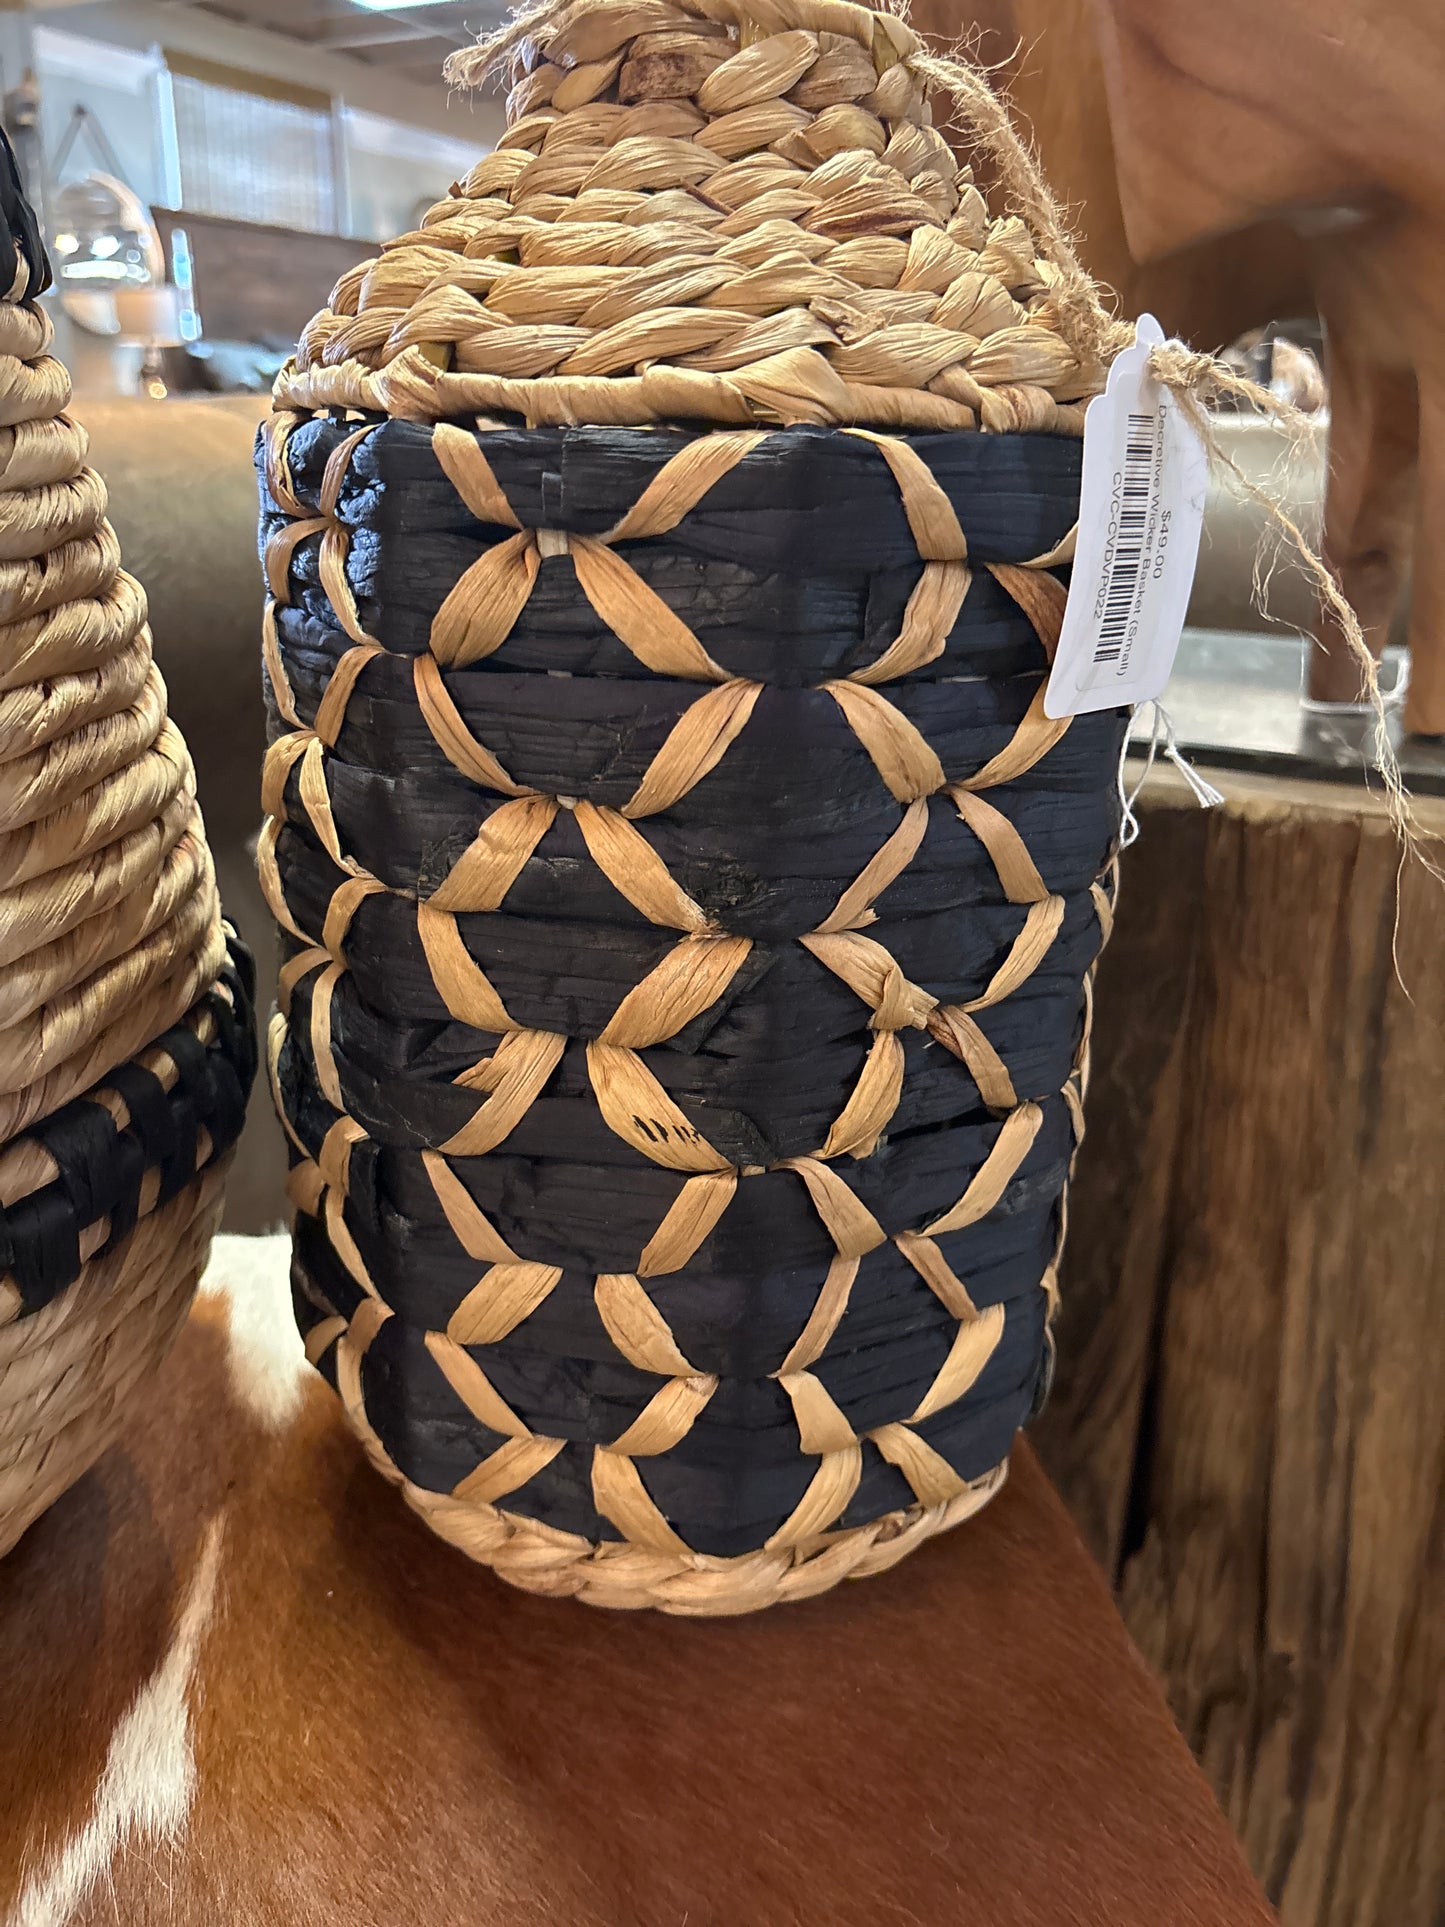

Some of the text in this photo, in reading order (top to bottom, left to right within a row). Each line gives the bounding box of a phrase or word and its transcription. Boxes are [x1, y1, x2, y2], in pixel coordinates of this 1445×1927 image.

[1094, 472, 1122, 619] CVC-CVDVP022
[1145, 494, 1160, 554] Wicker
[1153, 510, 1172, 579] $49.00
[1133, 558, 1151, 614] Basket
[1116, 620, 1139, 676] (Small)
